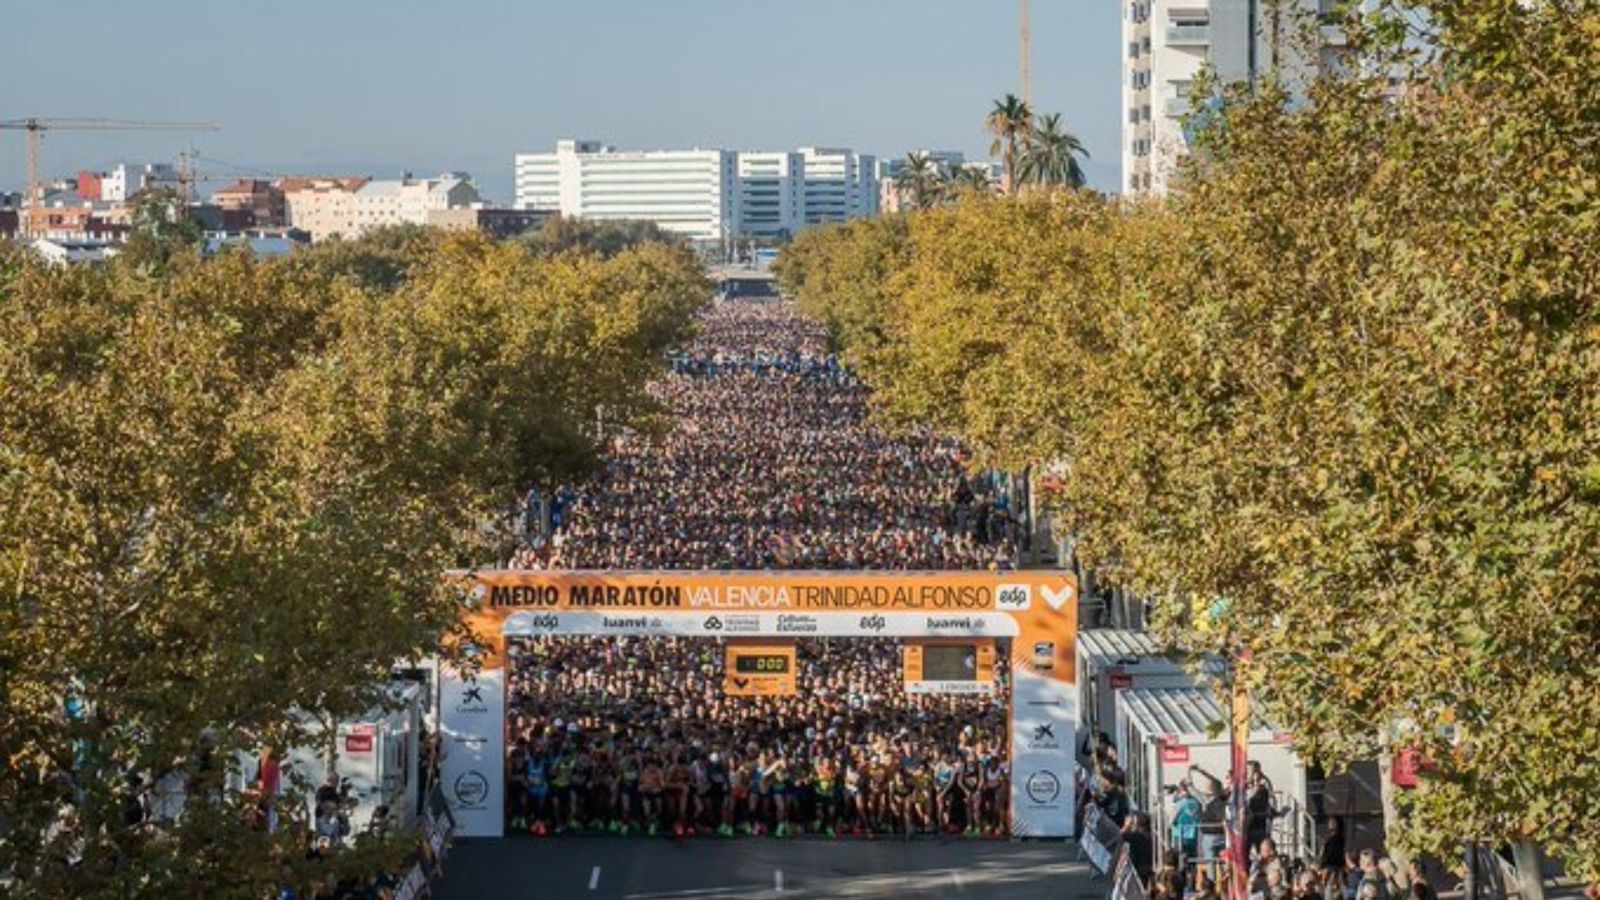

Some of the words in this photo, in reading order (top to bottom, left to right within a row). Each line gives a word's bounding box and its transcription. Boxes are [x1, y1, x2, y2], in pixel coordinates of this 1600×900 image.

[490, 586, 558, 606] MEDIO
[569, 579, 681, 606] MARATÓN
[685, 585, 791, 608] VALENCIA
[792, 586, 889, 607] TRINIDAD
[892, 586, 991, 608] ALFONSO
[1000, 587, 1026, 606] edp
[533, 613, 559, 630] edp
[859, 614, 886, 631] edp
